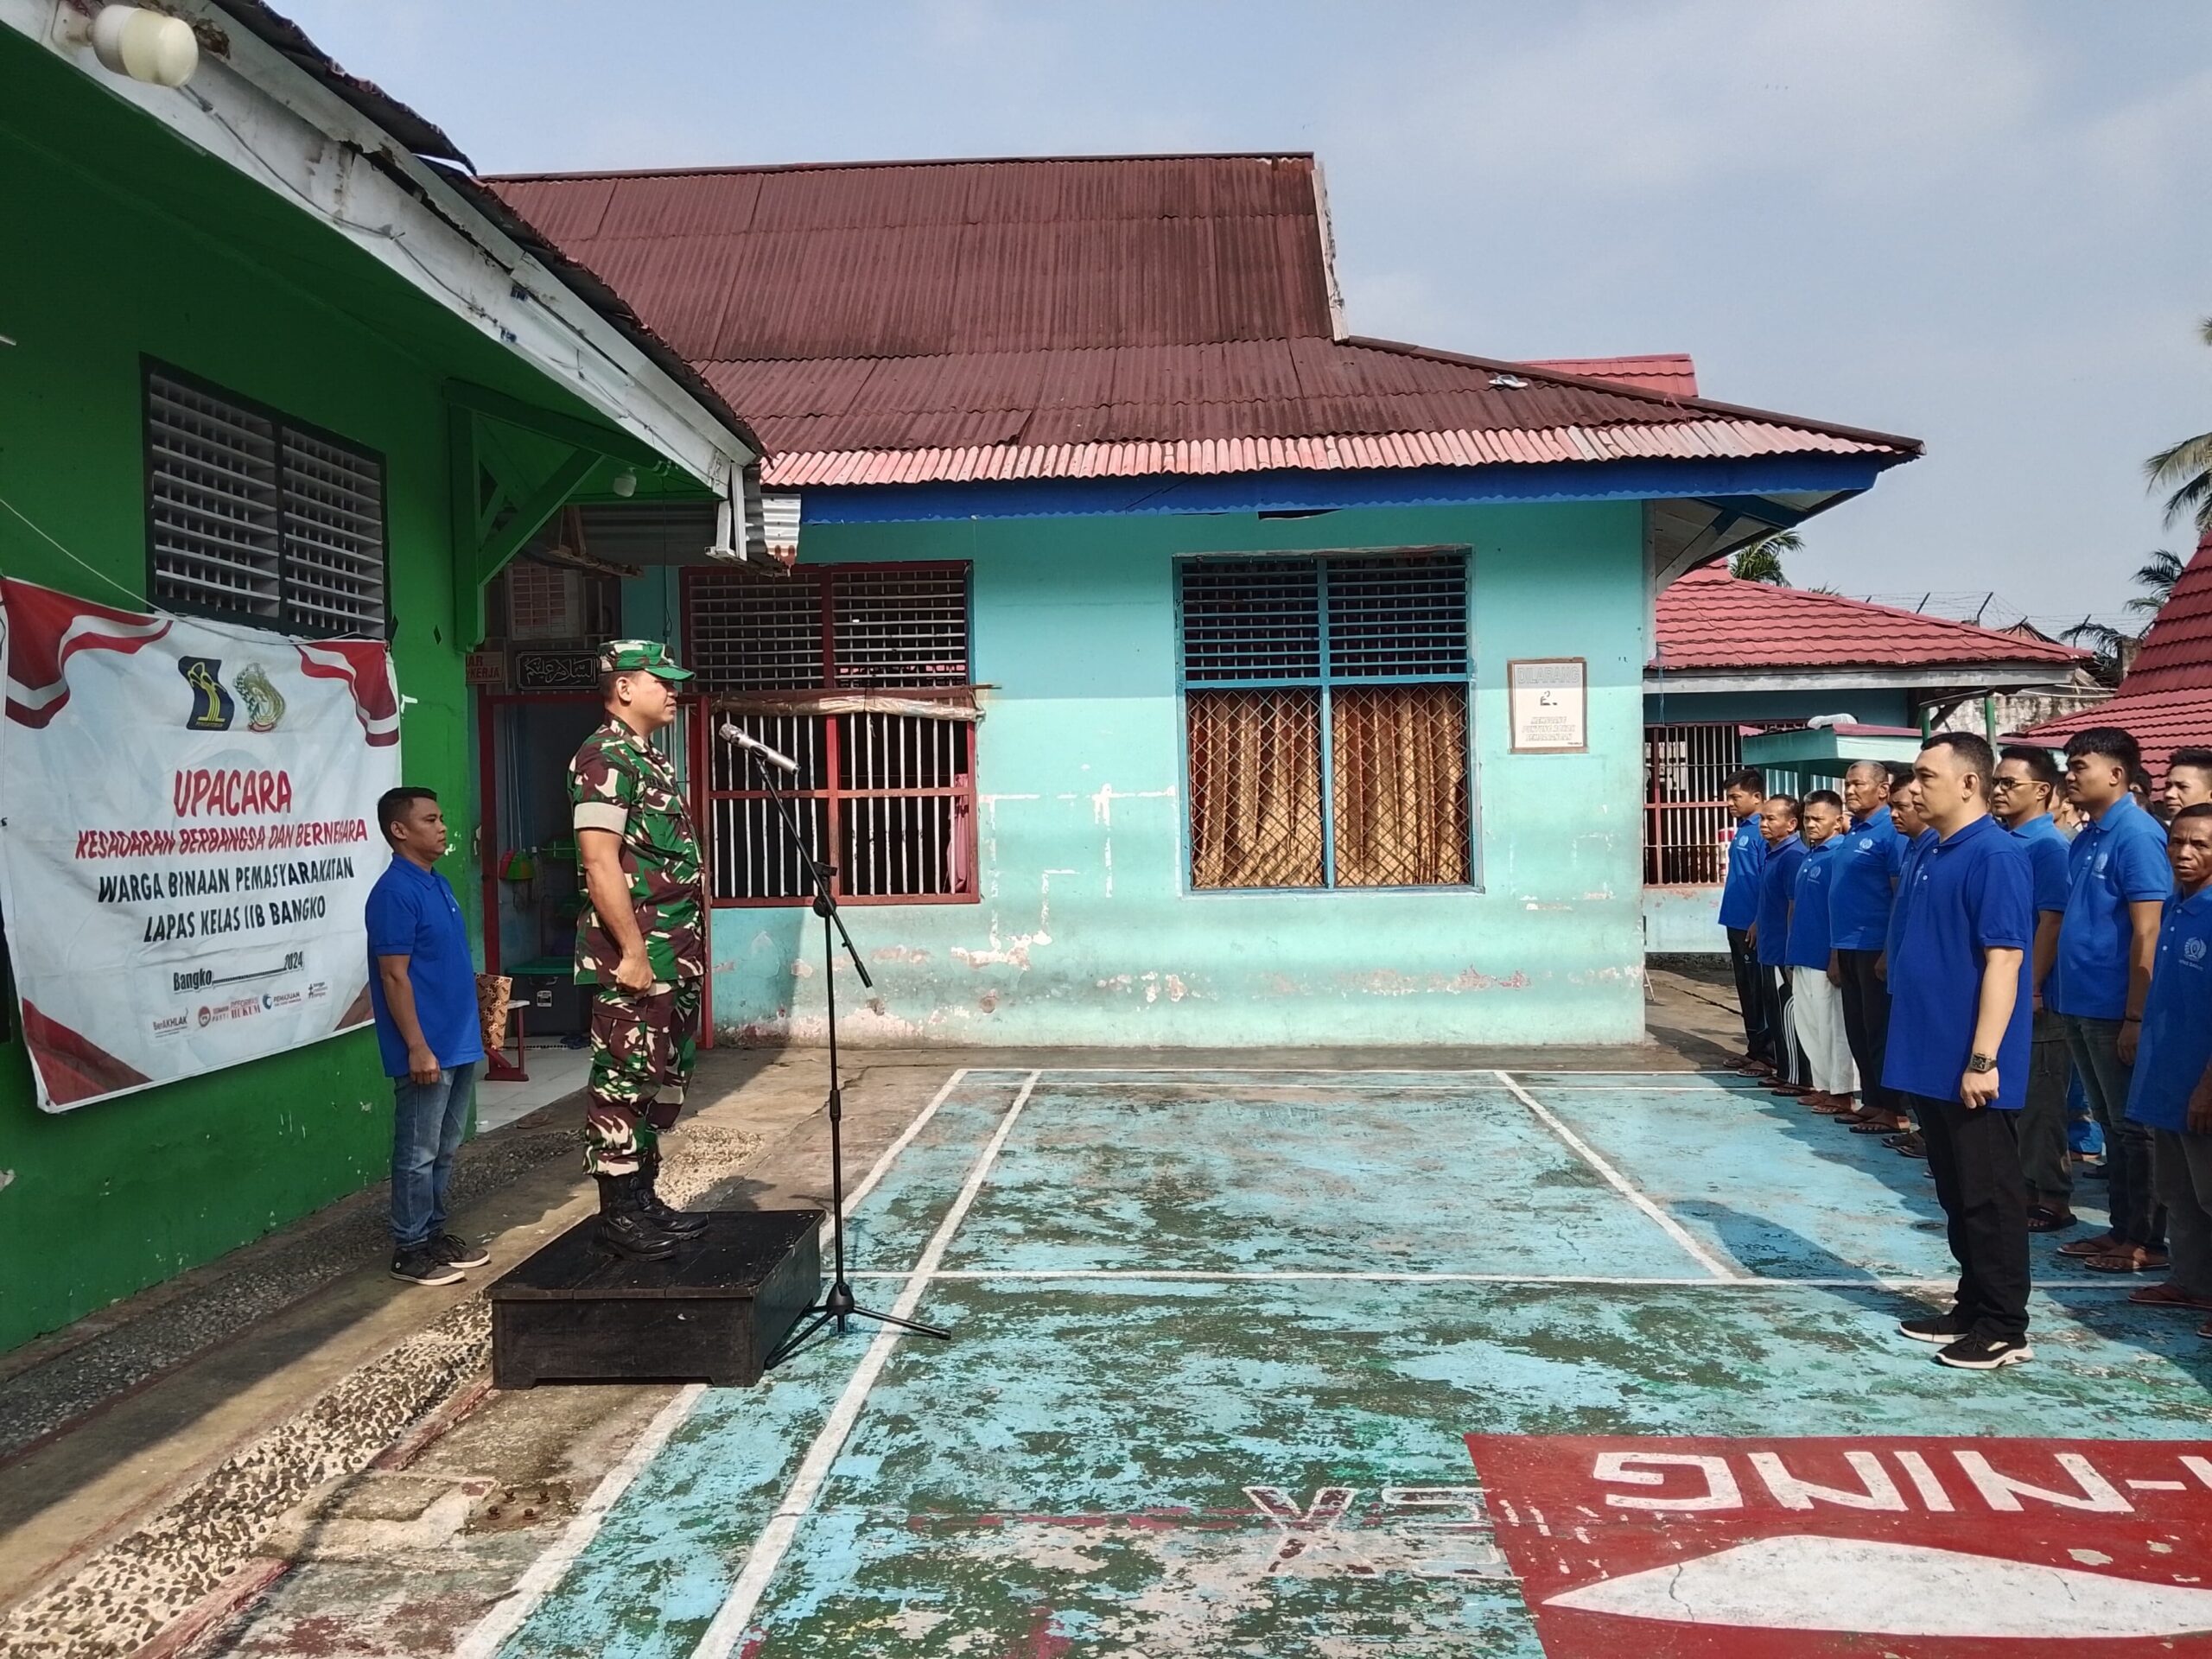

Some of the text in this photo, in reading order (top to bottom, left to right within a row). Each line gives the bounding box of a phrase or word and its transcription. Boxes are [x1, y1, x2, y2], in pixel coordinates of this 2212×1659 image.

[174, 768, 292, 817] UPACARA
[75, 819, 368, 859] KESADARAN BERBANGSA DAN BERNEGARA
[98, 856, 355, 903] WARGA BINAAN PEMASYARAKATAN
[143, 895, 327, 943] LAPAS KELAS IIB BANGKO
[283, 950, 303, 970] 2024
